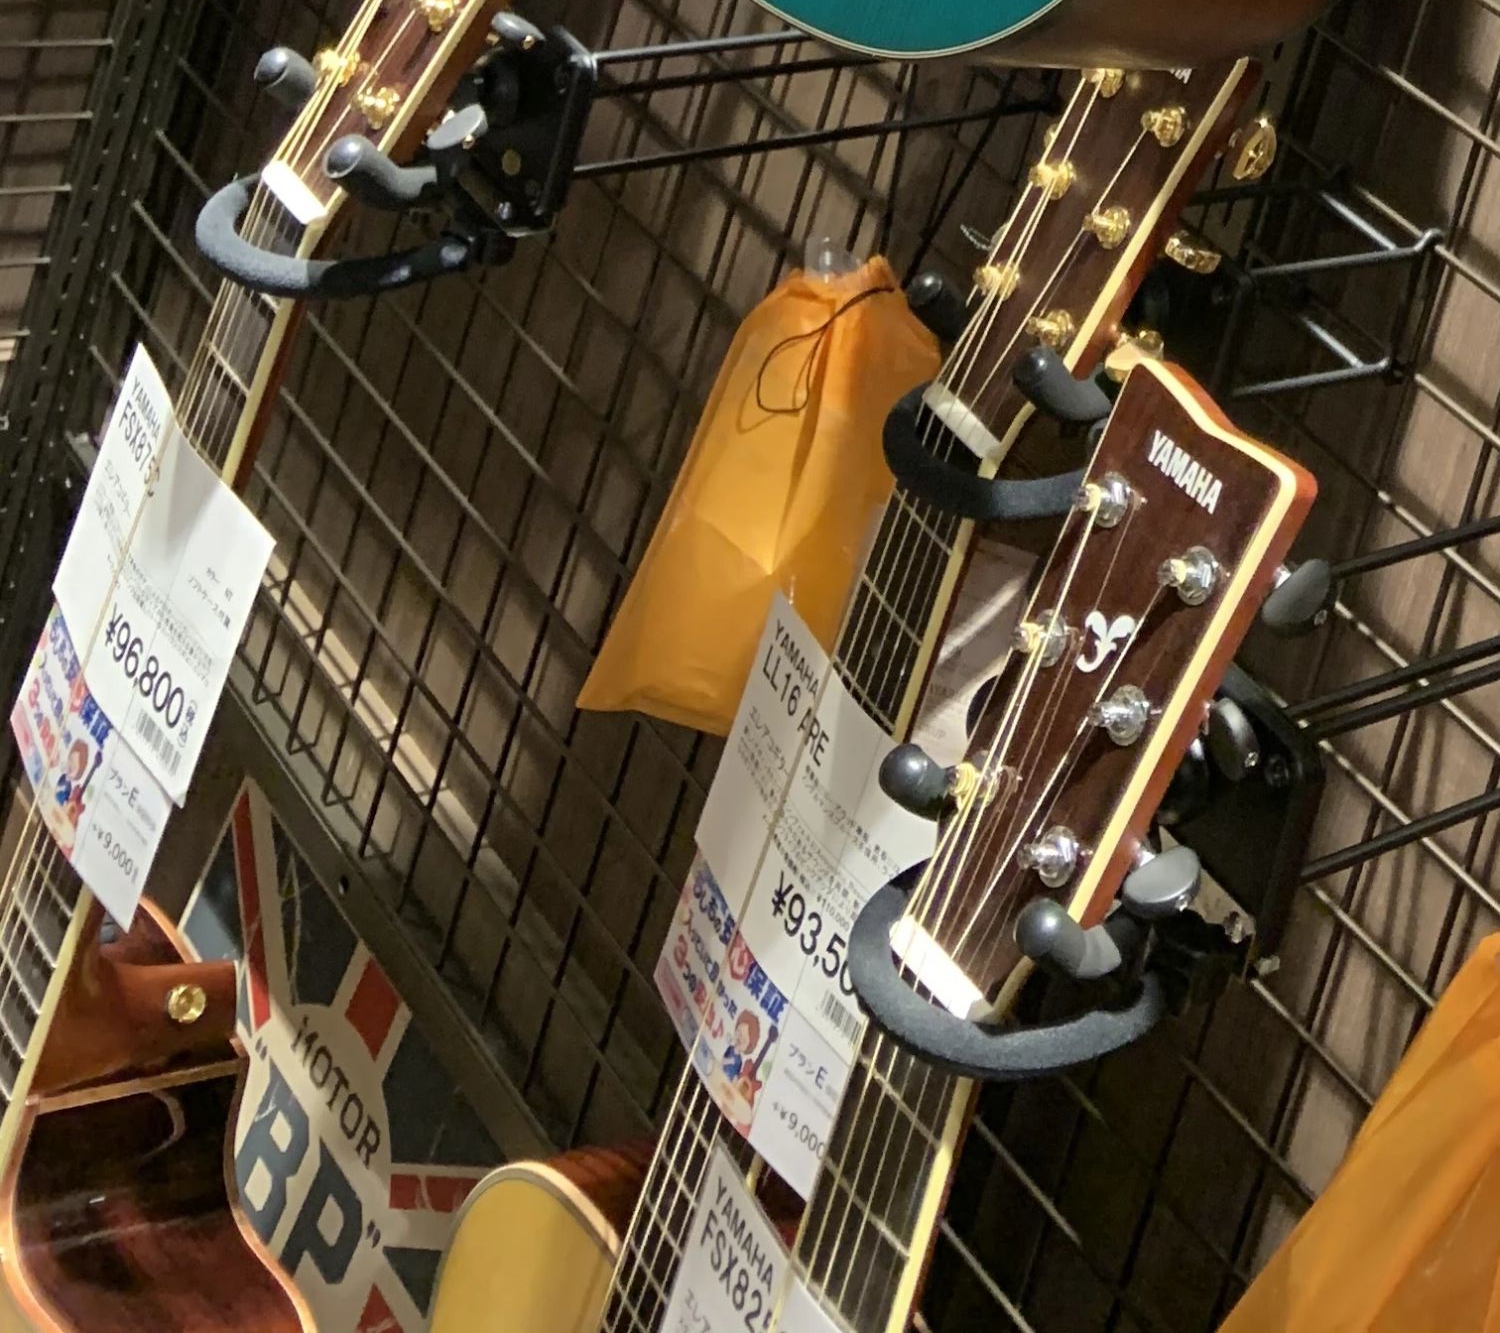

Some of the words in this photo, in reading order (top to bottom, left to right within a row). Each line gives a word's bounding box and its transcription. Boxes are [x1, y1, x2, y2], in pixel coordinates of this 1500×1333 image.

[1144, 429, 1224, 517] YAMAHA
[105, 602, 185, 729] ¥96,800
[774, 618, 821, 699] YAMAHA
[715, 1176, 774, 1294] YAMAHA
